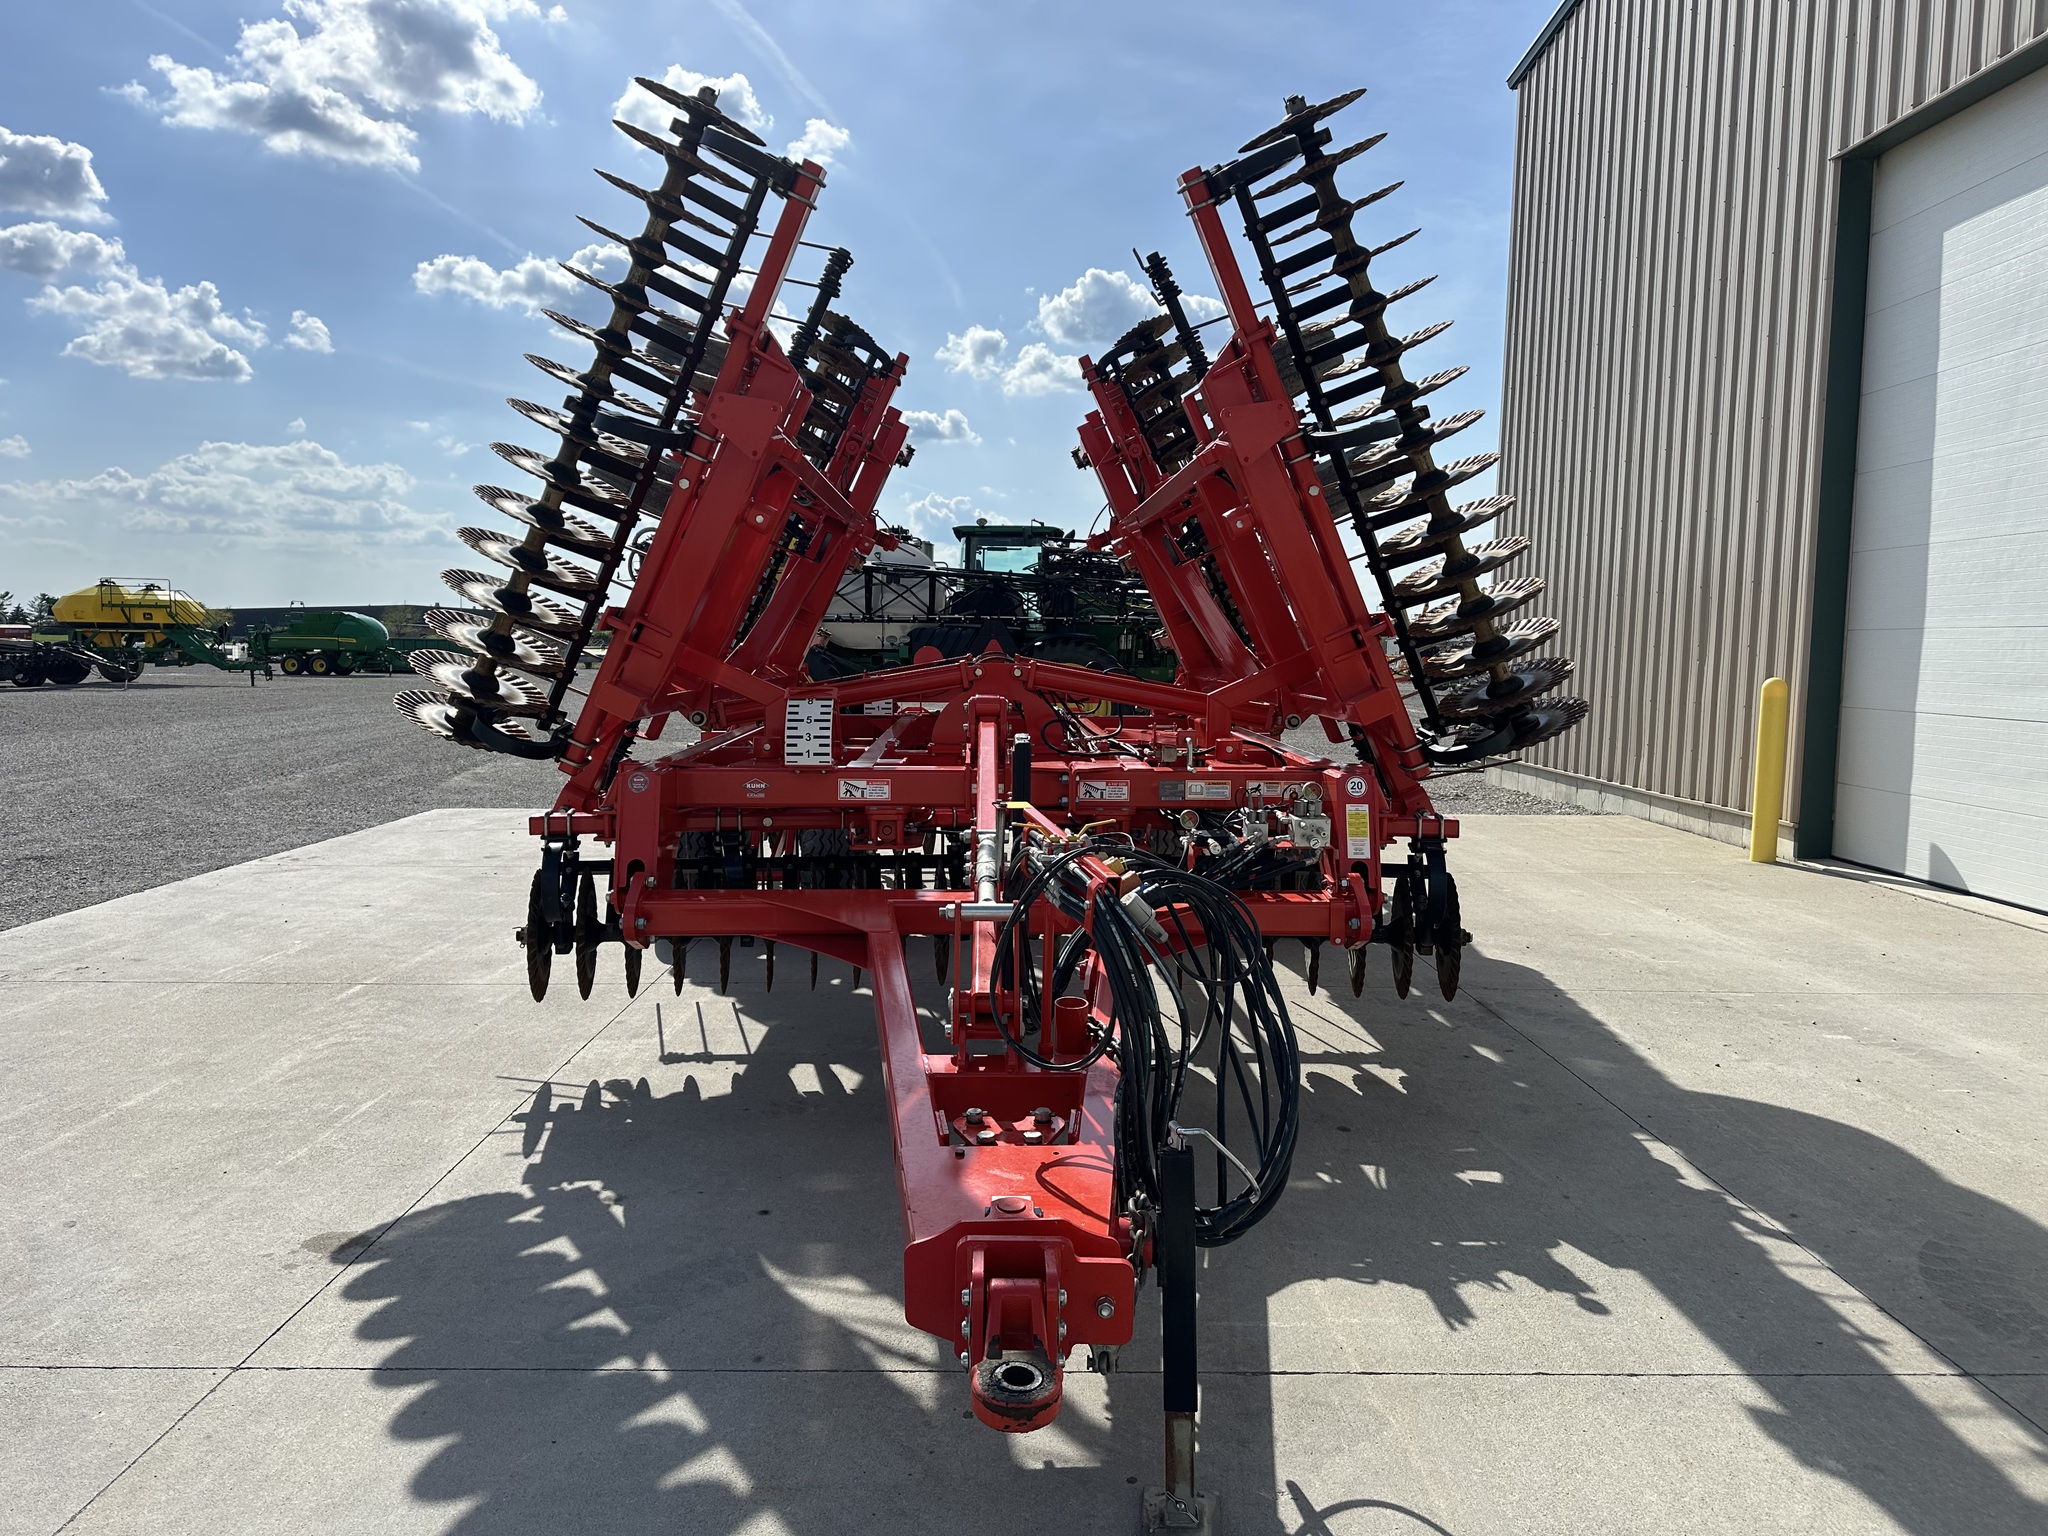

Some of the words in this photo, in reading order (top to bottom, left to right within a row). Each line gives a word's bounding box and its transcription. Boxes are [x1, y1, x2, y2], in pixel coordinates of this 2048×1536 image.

[805, 716, 812, 724] 5
[805, 732, 812, 742] 3
[805, 749, 811, 758] 1
[1350, 780, 1363, 791] 20
